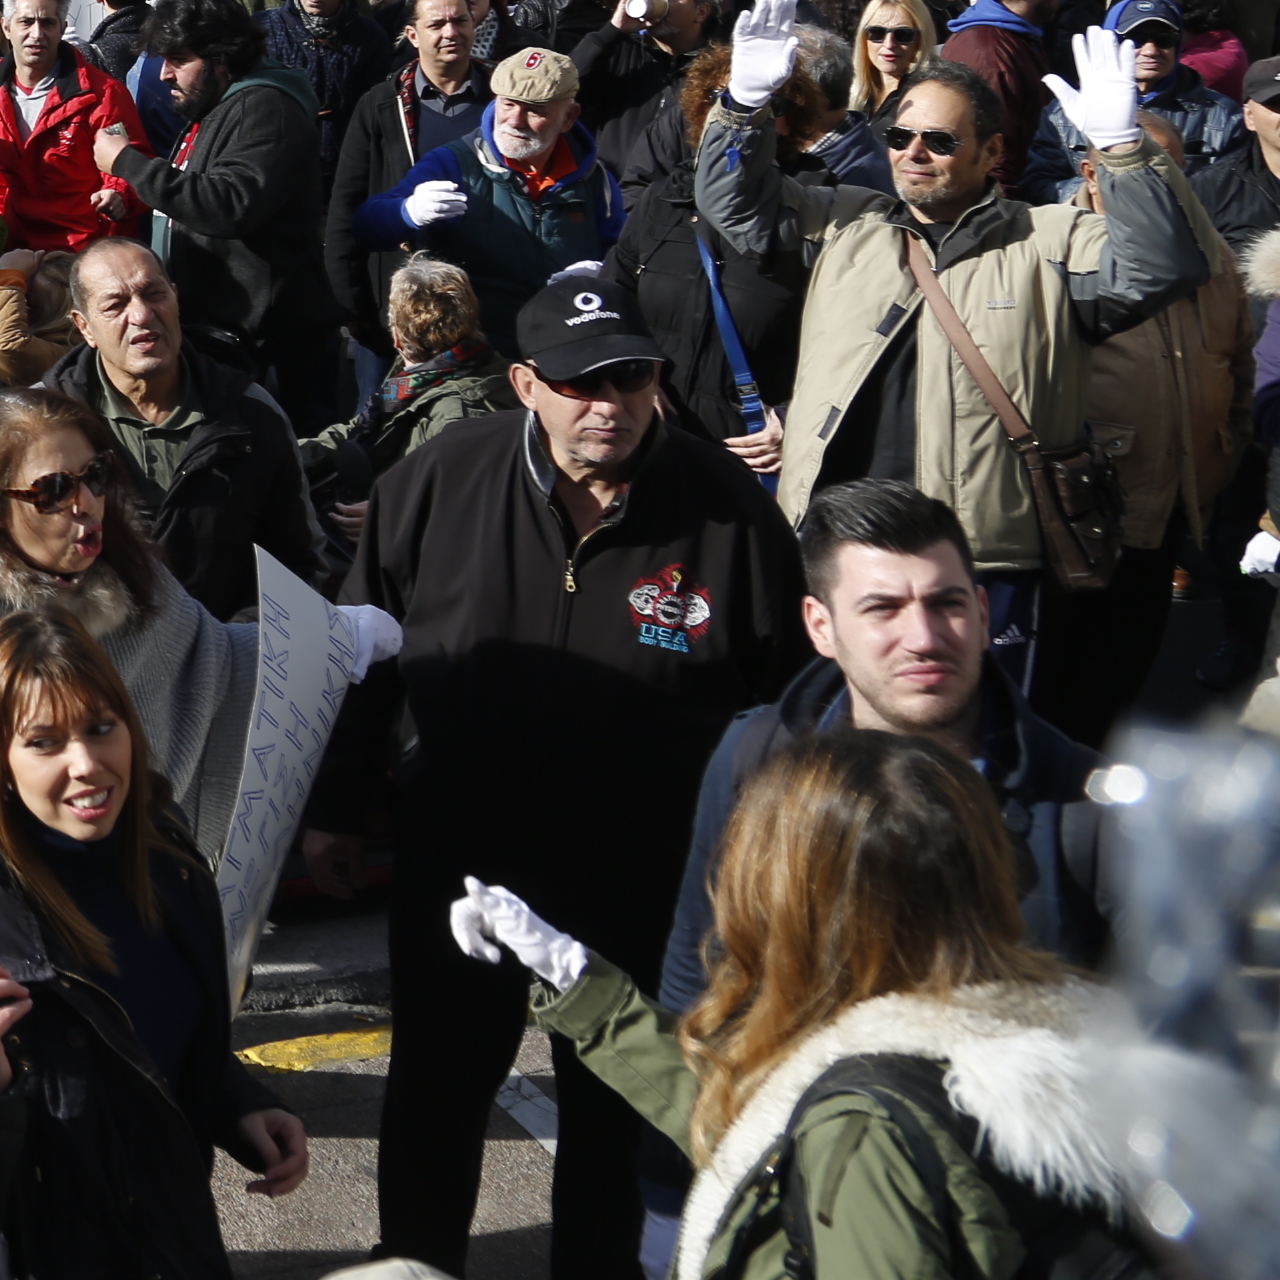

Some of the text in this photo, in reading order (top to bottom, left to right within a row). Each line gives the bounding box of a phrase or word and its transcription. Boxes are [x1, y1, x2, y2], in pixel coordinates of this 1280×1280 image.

[525, 51, 546, 69] 6
[564, 309, 621, 327] vodafone
[640, 622, 688, 646] USA
